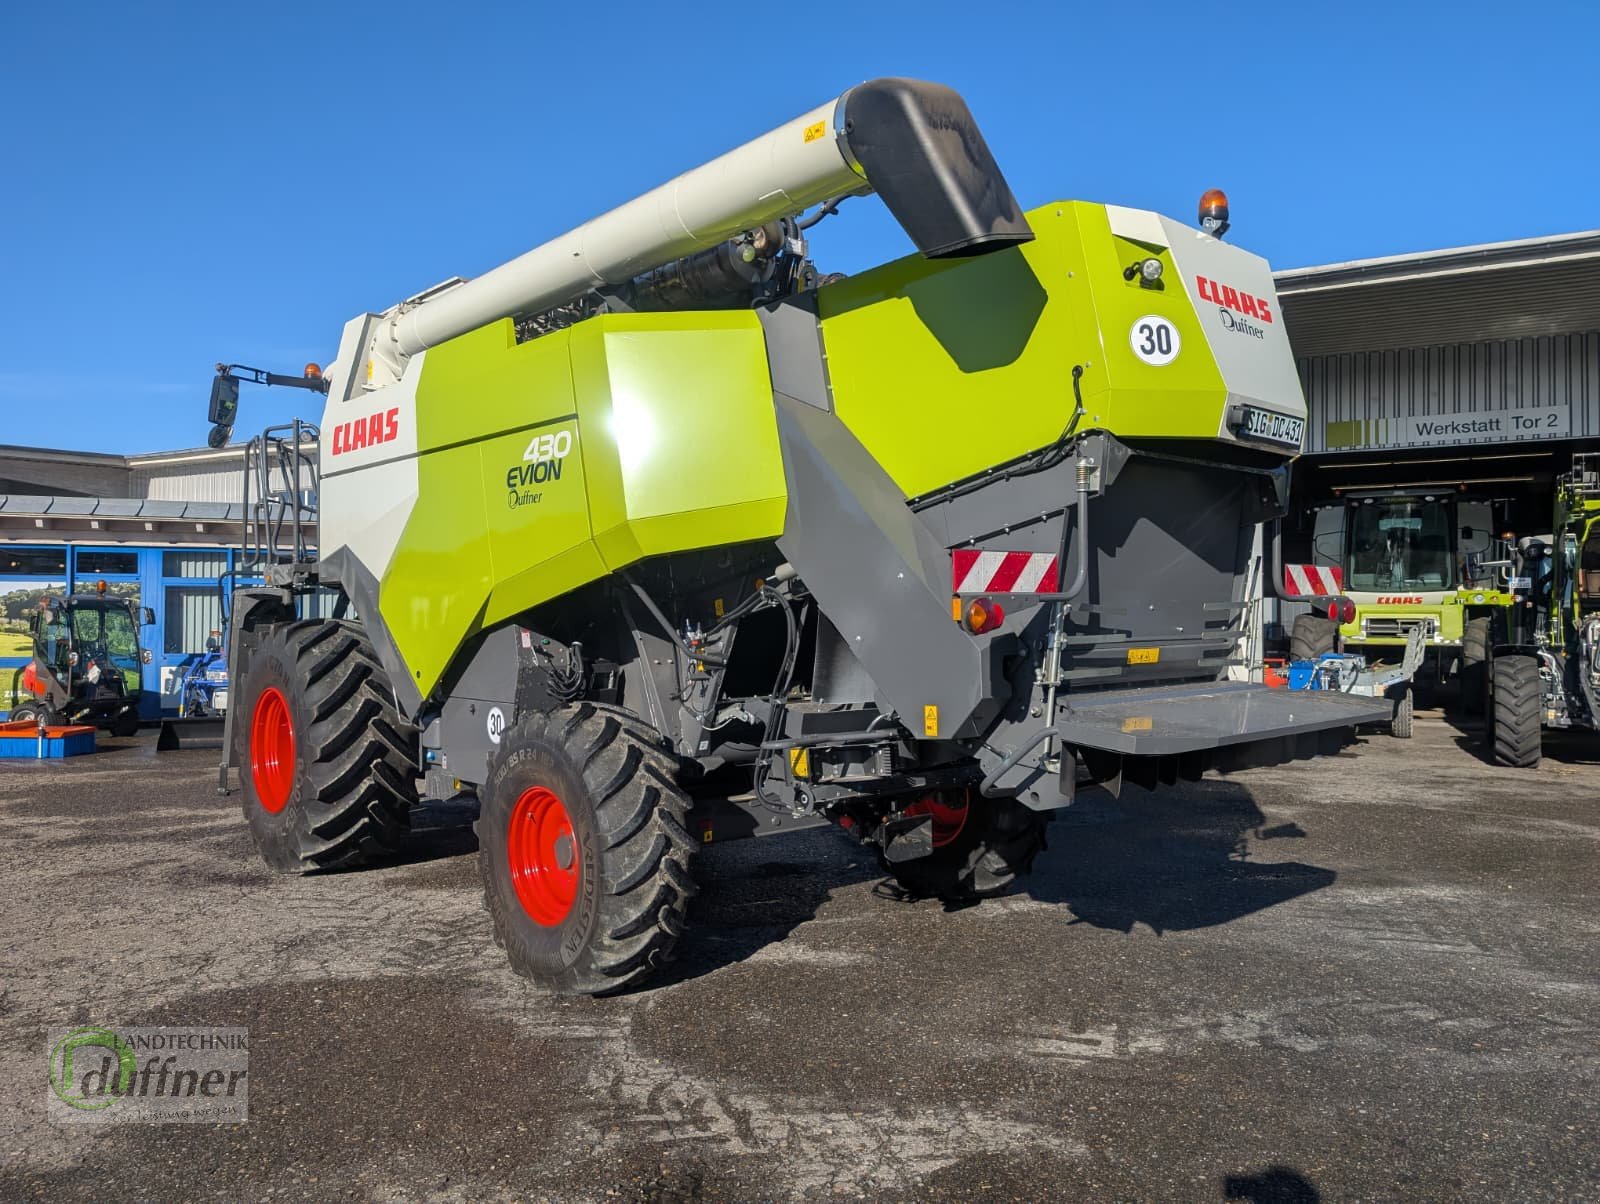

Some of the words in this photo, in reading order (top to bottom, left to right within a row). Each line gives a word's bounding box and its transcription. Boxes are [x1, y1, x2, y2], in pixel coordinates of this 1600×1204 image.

[1196, 275, 1273, 324] CLAAS
[1219, 307, 1264, 339] Duffner
[1139, 324, 1172, 355] 30
[332, 408, 399, 456] CLAAS
[1248, 411, 1267, 434] SIG
[1416, 419, 1501, 437] Werkstatt
[1512, 417, 1541, 430] Tor
[1547, 414, 1558, 427] 2
[523, 431, 571, 463] 430
[507, 458, 562, 488] EVION
[490, 713, 502, 736] 30
